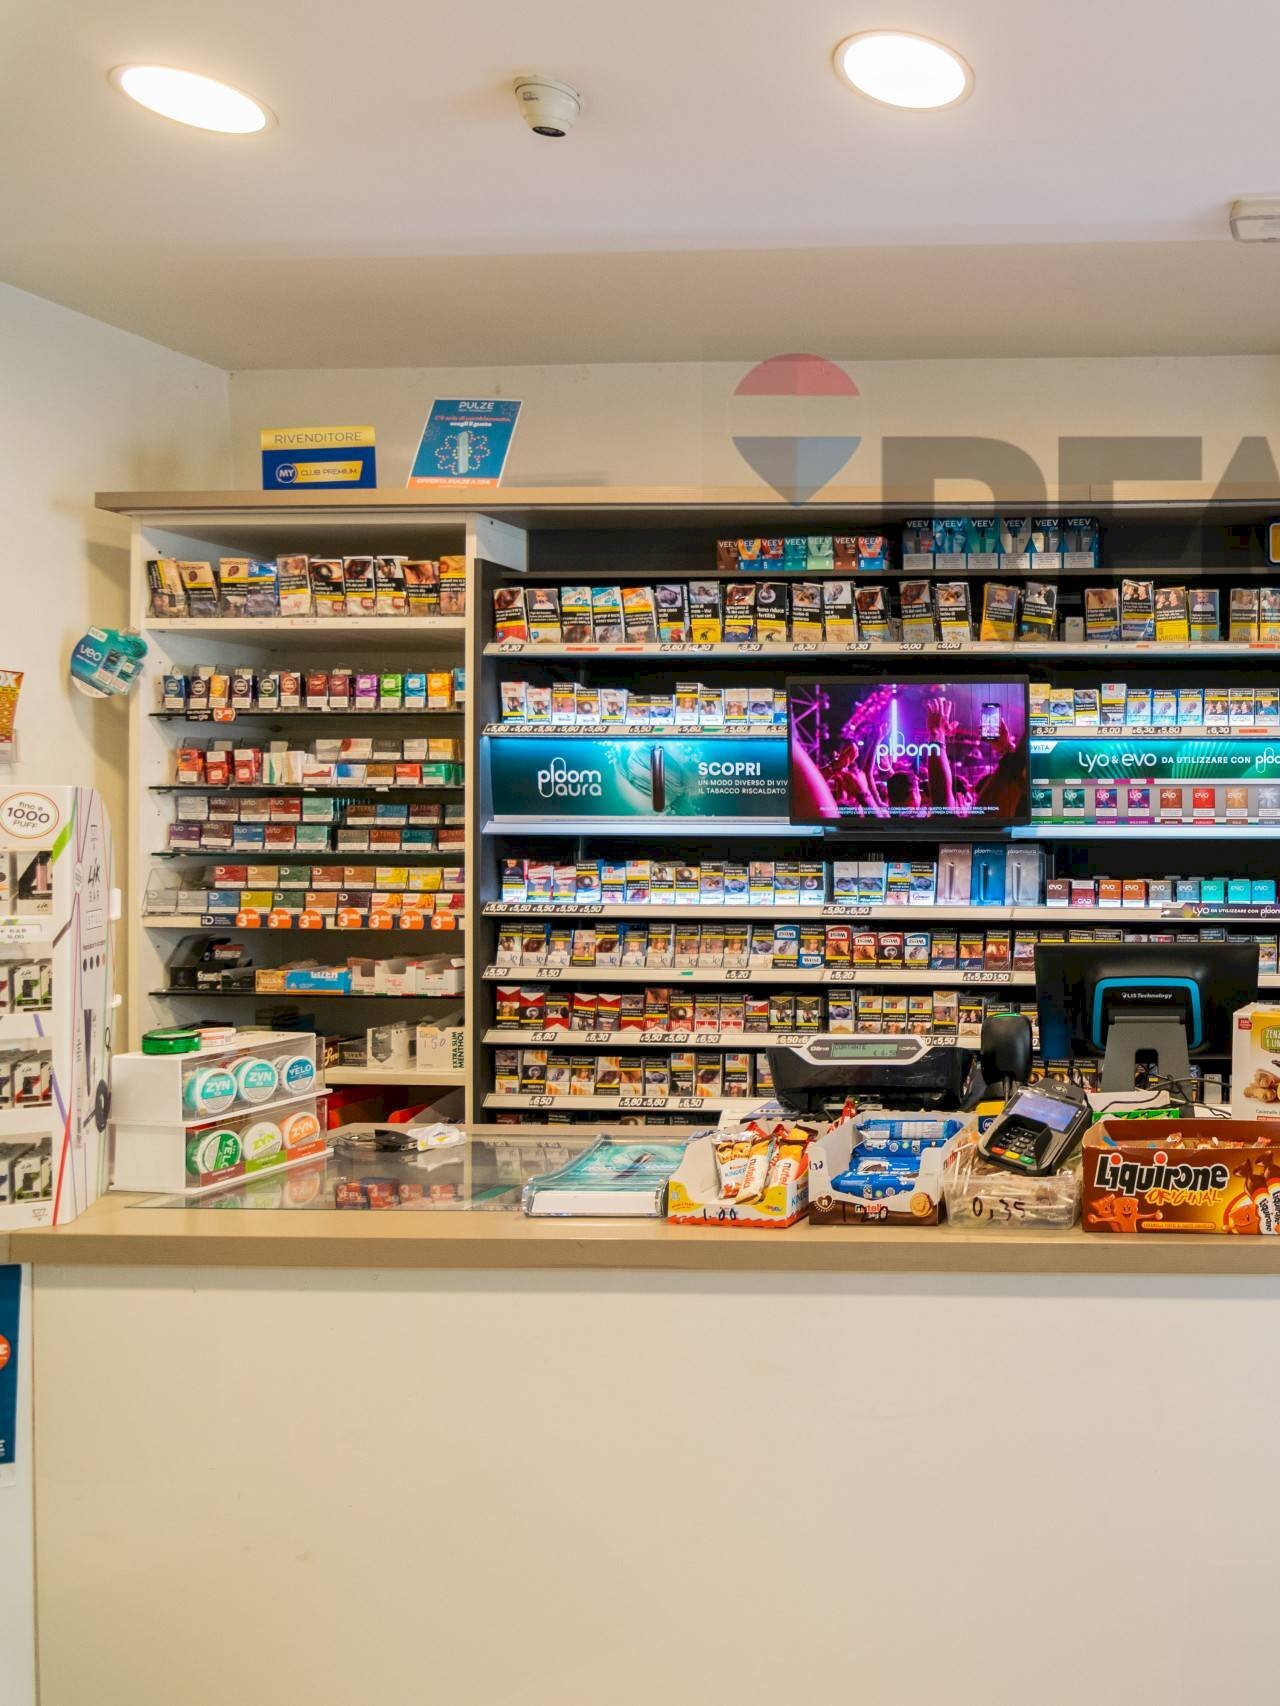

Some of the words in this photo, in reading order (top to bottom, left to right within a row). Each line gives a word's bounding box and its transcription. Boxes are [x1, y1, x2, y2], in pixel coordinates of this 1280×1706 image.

[459, 401, 494, 410] PULZE
[274, 431, 362, 445] RIVENDITORE
[279, 469, 294, 478] MY
[301, 469, 320, 477] CLUB
[907, 520, 929, 528] VEEV
[939, 520, 963, 528] VEEV
[971, 520, 995, 528] VEEV
[1003, 520, 1027, 528] VEEV
[1035, 519, 1059, 527] VEEV
[1067, 518, 1091, 526] VEEV
[762, 538, 783, 546] VEEV
[876, 731, 941, 772] ploom
[1079, 752, 1109, 773] Lyo
[1121, 752, 1156, 767] evo
[1161, 756, 1174, 764] DA
[1176, 756, 1229, 764] UTILIZZARE
[1231, 756, 1251, 764] CON
[538, 757, 602, 787] ploom
[698, 761, 761, 776] SCOPRI
[555, 783, 602, 797] aura
[1195, 790, 1209, 799] evo
[7, 807, 50, 824] 1000
[13, 819, 38, 829] PUFF
[1192, 906, 1210, 916] Lyo
[1137, 992, 1173, 1000] Technology
[249, 1070, 273, 1082] ZYN
[206, 1080, 231, 1092] ZYN
[292, 1121, 314, 1136] ZYN
[252, 1131, 276, 1150] ZYN
[1095, 1151, 1229, 1193] Liquirone
[1145, 1189, 1223, 1206] ORIGINAL
[972, 1196, 1025, 1221] 0,35
